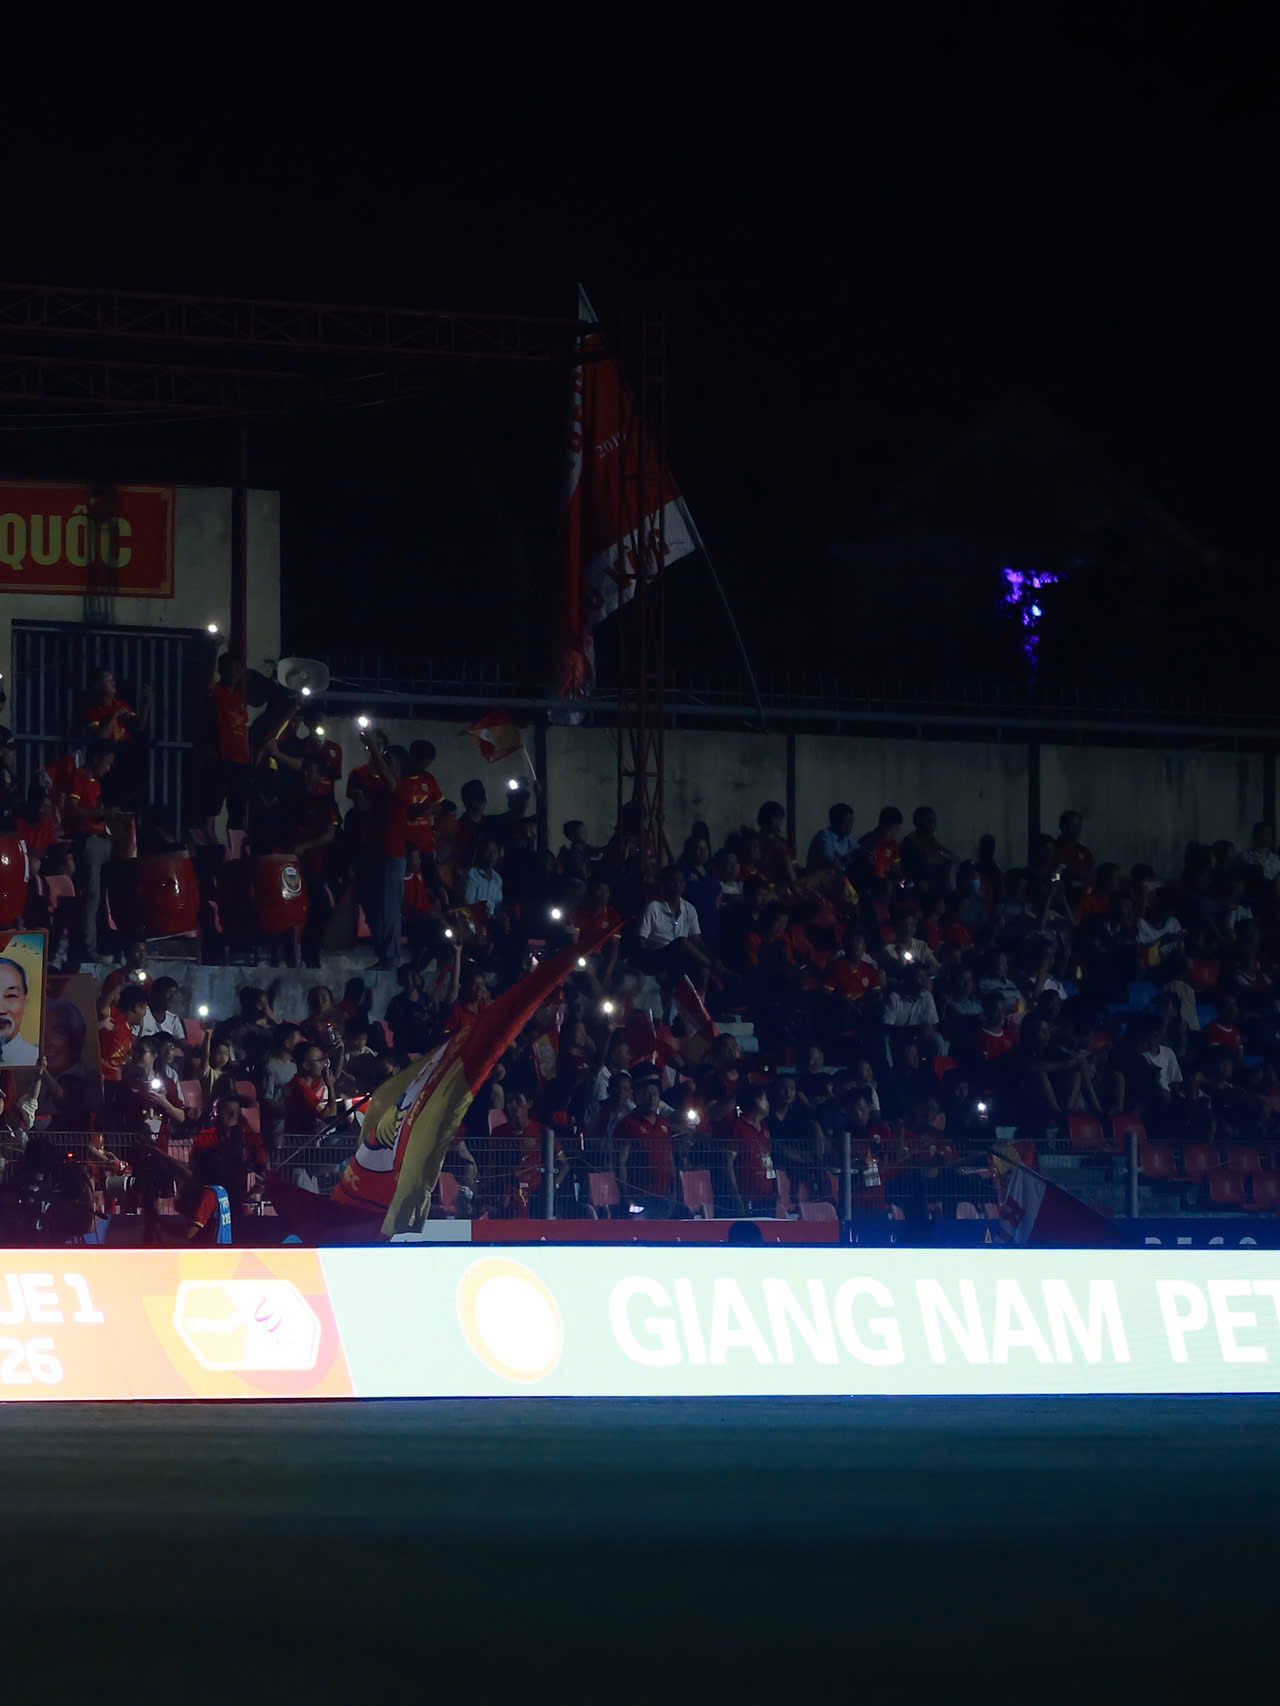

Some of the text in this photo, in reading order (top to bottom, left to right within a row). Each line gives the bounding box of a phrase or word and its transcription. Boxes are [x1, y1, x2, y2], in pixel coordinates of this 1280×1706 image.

[64, 1273, 105, 1323] 1
[607, 1275, 906, 1367] GIANG
[915, 1278, 1132, 1365] NAM
